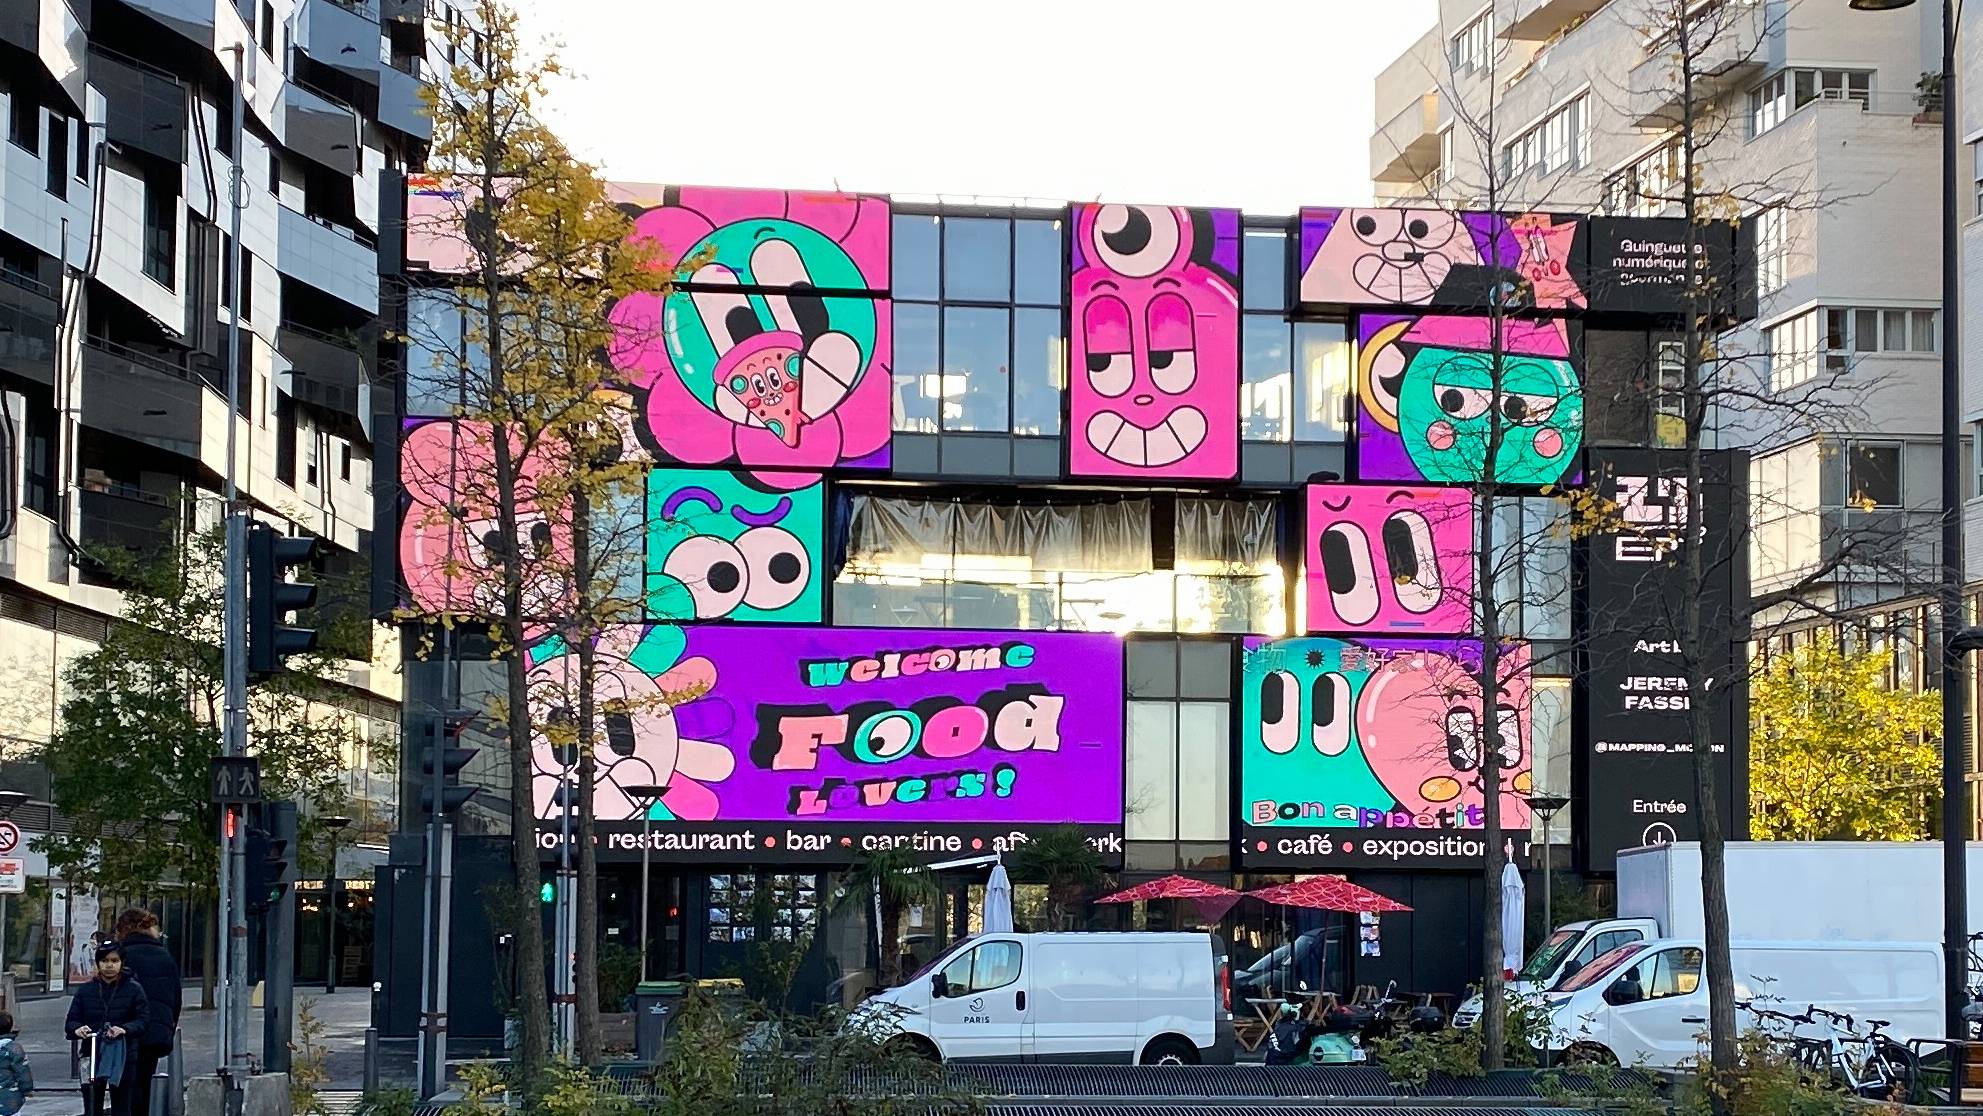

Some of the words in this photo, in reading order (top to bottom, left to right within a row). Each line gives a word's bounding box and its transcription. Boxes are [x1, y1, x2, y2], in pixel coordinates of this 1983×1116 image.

[1620, 239, 1703, 256] Guinguete
[1633, 639, 1671, 653] Art
[1251, 799, 1325, 825] Bon
[1633, 799, 1687, 813] Entrée
[608, 829, 755, 850] restaurant
[786, 829, 832, 851] bar
[1277, 833, 1333, 856] café
[963, 1016, 991, 1024] PARIS
